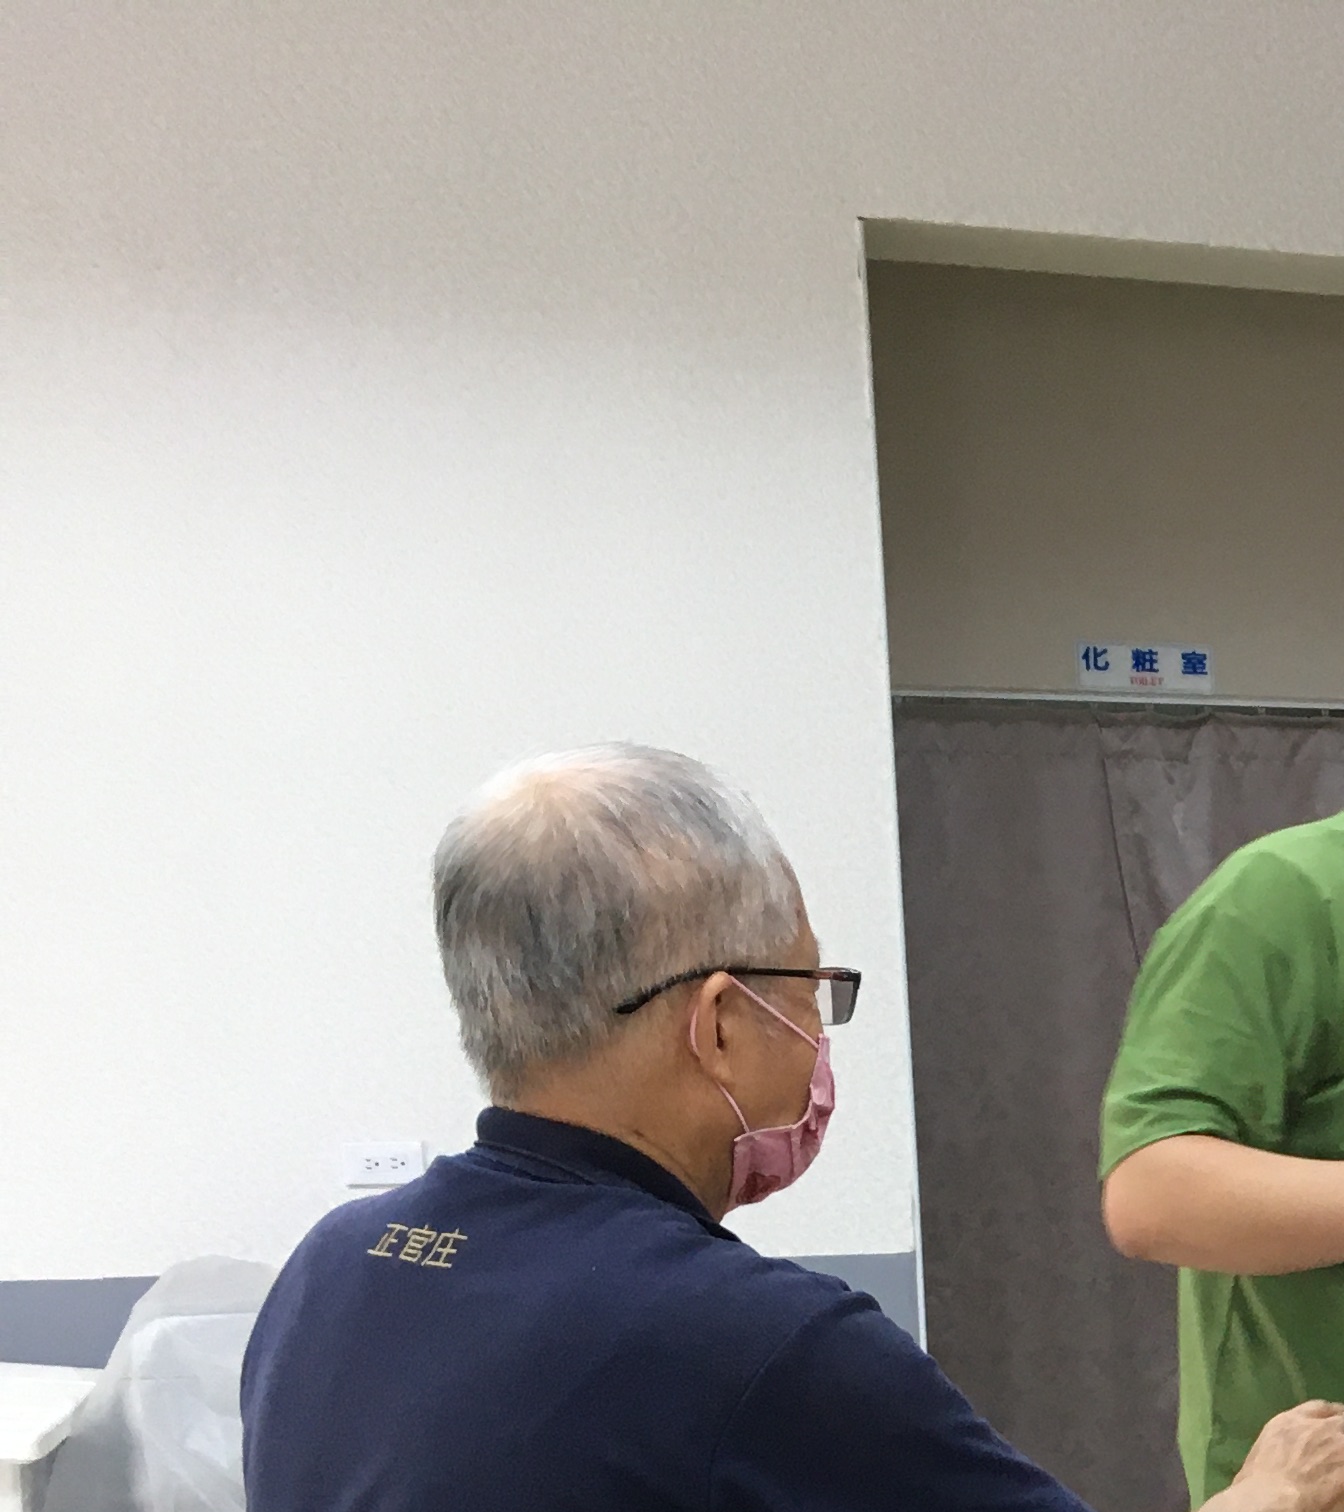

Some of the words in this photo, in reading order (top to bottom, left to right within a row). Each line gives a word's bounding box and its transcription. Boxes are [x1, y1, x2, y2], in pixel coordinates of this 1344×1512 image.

[1081, 645, 1208, 676] 化粧室
[367, 1224, 468, 1268] 正官庄
